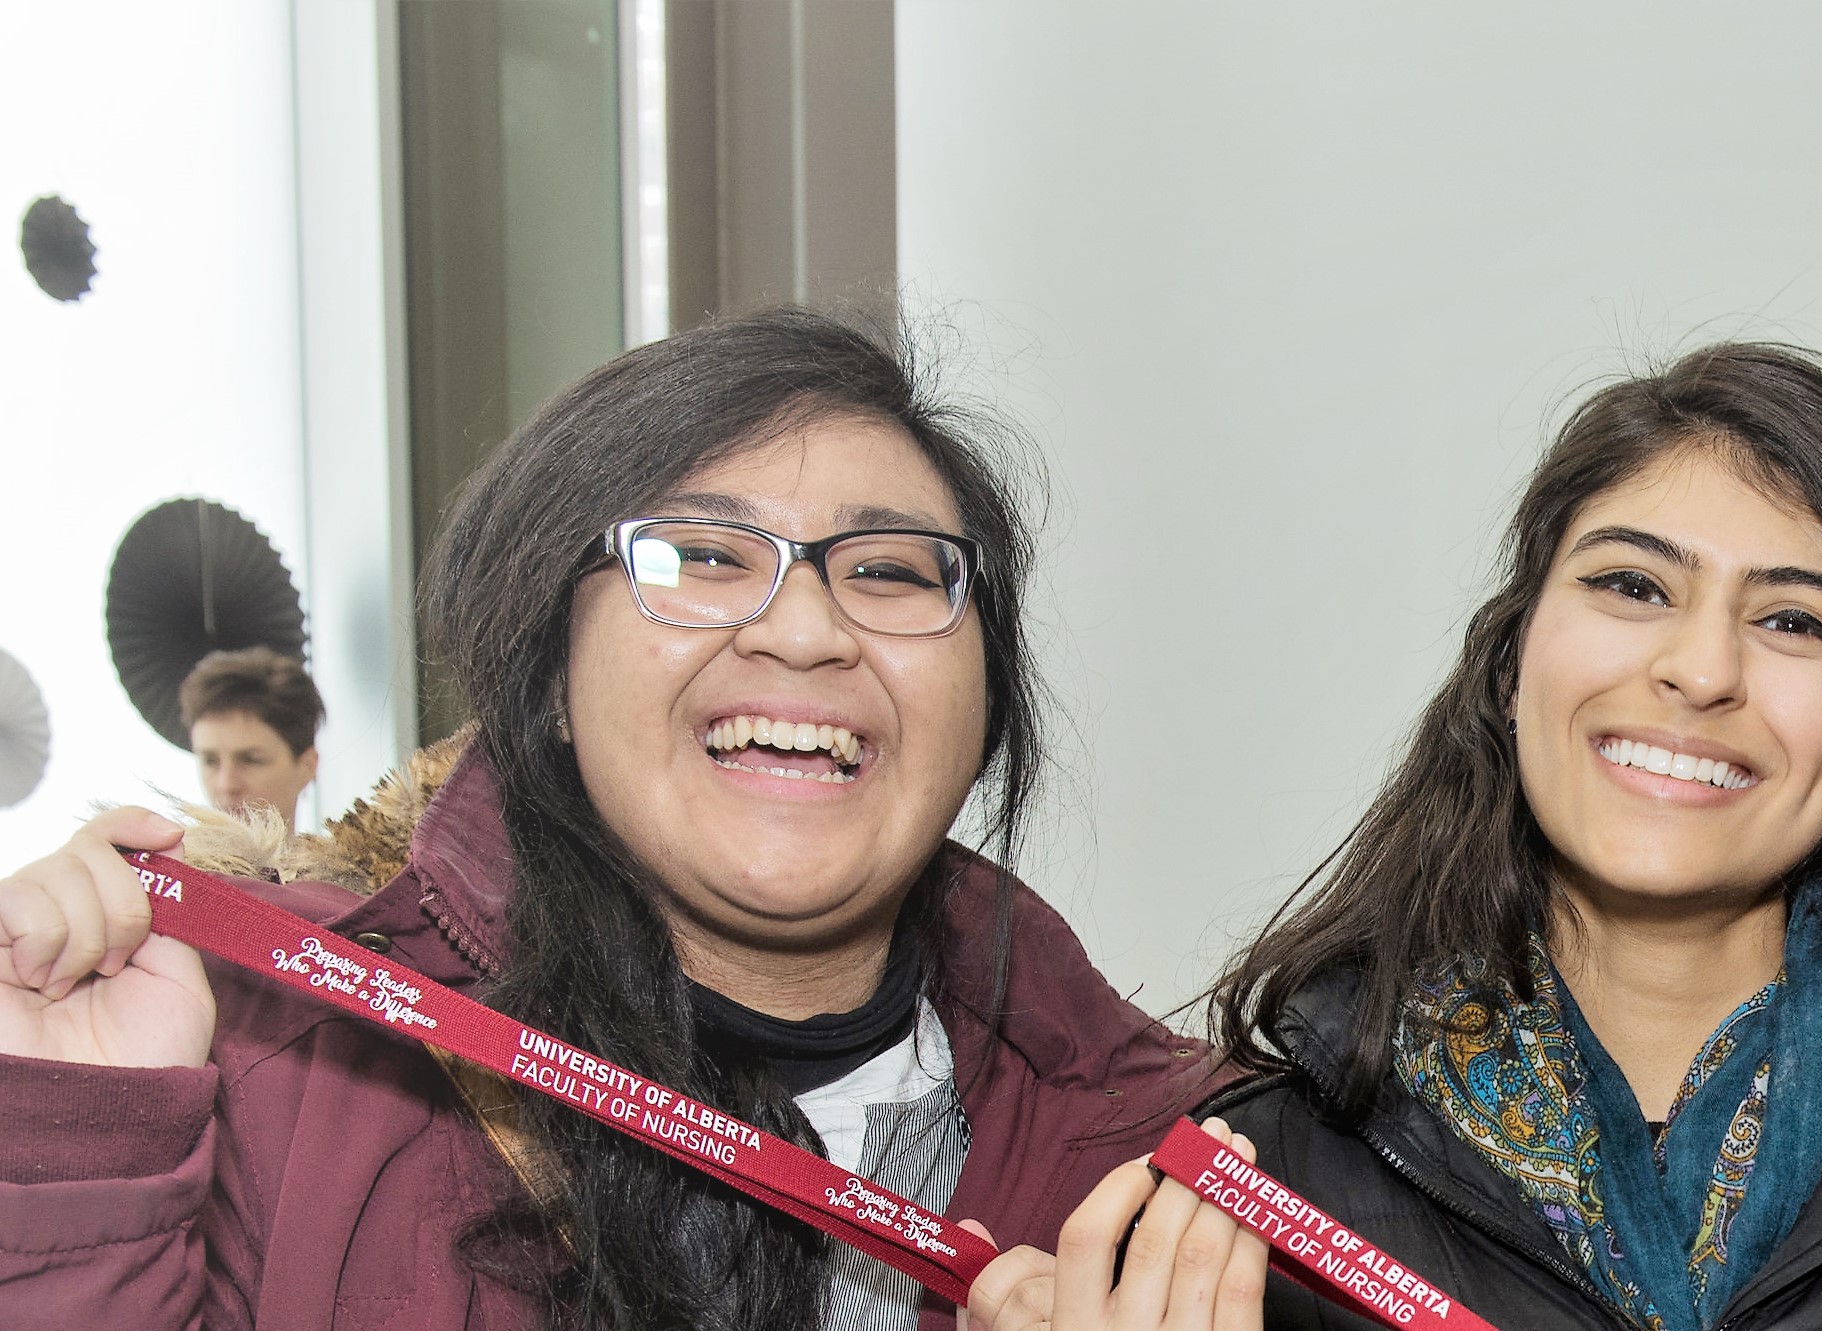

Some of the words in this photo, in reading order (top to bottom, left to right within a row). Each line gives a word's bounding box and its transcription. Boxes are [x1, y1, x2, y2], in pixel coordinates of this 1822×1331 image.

[272, 949, 310, 974] Who
[310, 970, 356, 995] Make
[358, 990, 370, 1001] a
[370, 990, 438, 1029] Difference
[299, 937, 368, 983] Preparing
[370, 969, 422, 1005] Leaders
[511, 1054, 608, 1110] FACULTY
[610, 1098, 640, 1122] OF
[642, 1110, 736, 1165] NURSING
[519, 1029, 642, 1097] UNIVERSITY
[645, 1086, 672, 1108] OF
[673, 1099, 761, 1151] ALBERTA
[825, 1188, 855, 1208] Who
[856, 1204, 892, 1227] Make
[894, 1222, 903, 1231] a
[903, 1223, 957, 1257] Difference
[846, 1178, 900, 1217] Preparing
[901, 1205, 943, 1236] Leaders
[1194, 1170, 1291, 1240] FACULTY
[1287, 1231, 1322, 1257] OF
[1317, 1250, 1416, 1323] NURSING
[1212, 1149, 1334, 1235] UNIVERSITY
[1331, 1228, 1363, 1254] OF
[1357, 1250, 1451, 1319] ALBERTA
